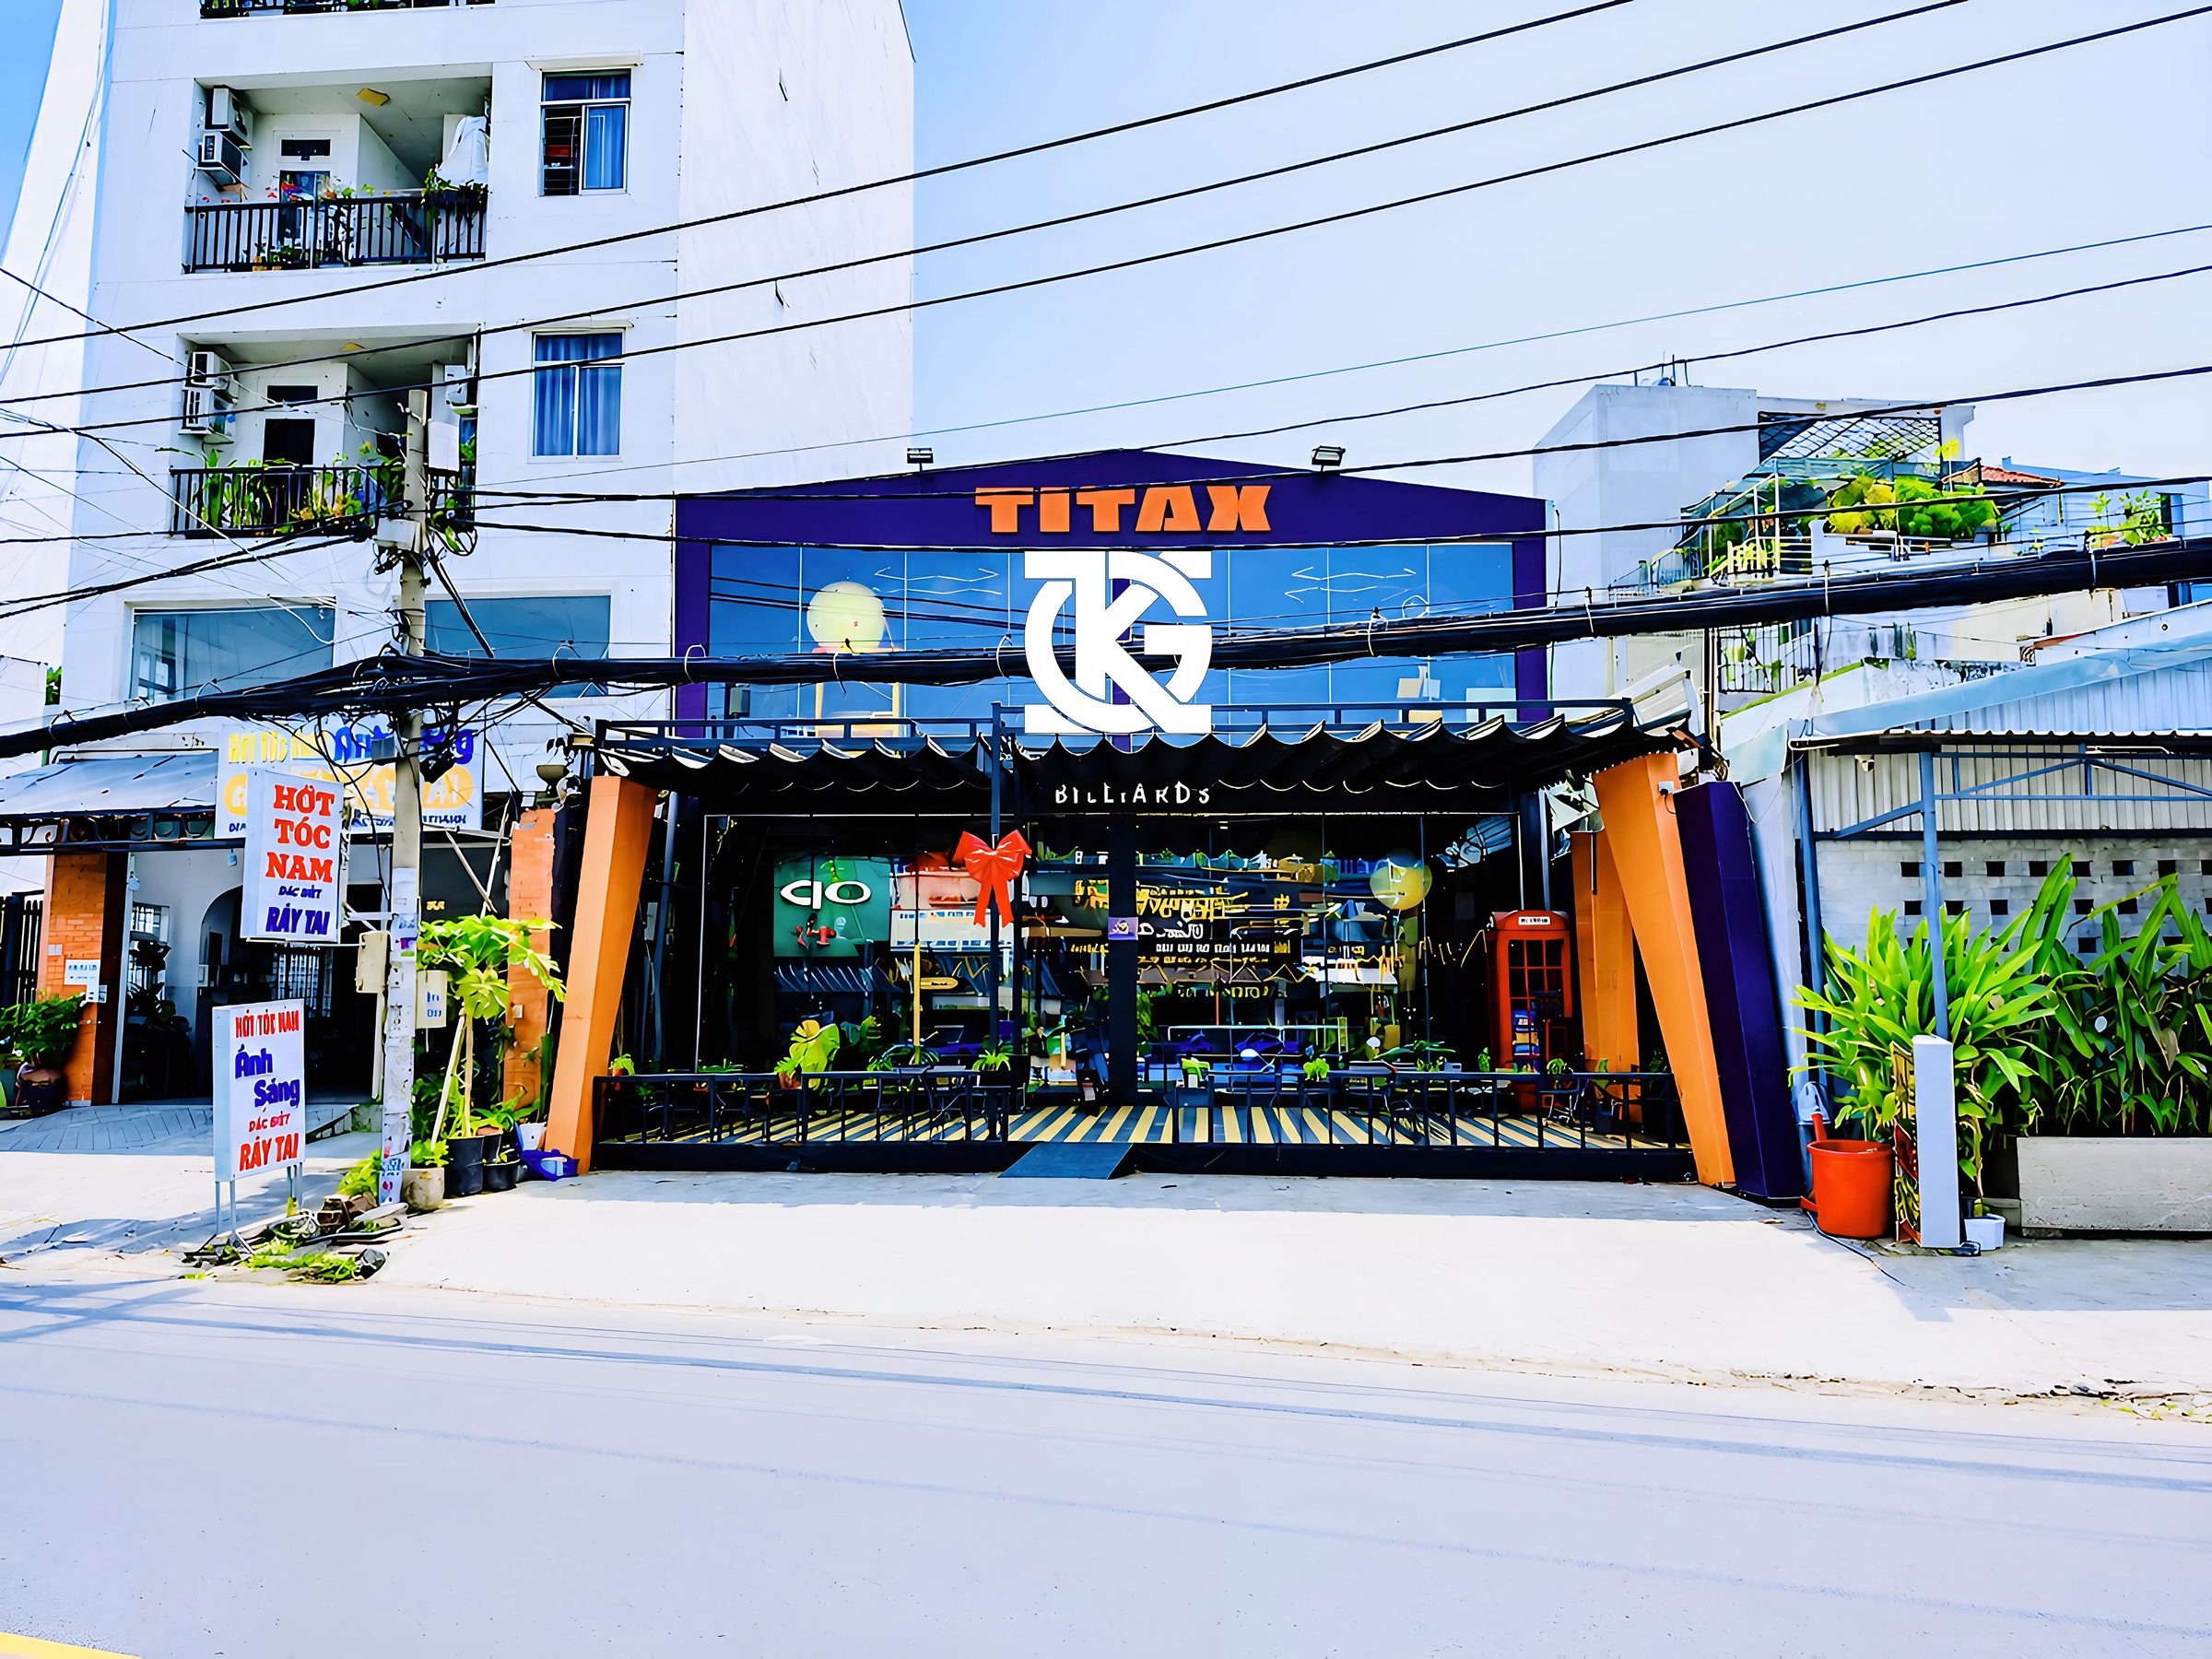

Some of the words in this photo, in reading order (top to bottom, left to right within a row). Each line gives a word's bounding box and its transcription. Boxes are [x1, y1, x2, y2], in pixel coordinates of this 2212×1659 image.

[974, 485, 1272, 533] TITAX
[1054, 782, 1210, 805] BILLIARDS
[274, 816, 332, 849] TÓC
[265, 852, 333, 883] NAM
[265, 902, 303, 934] RÁY
[305, 910, 331, 935] TAI
[235, 1043, 273, 1079] Ánh
[253, 1077, 300, 1108] Sáng
[240, 1135, 272, 1171] RÁY
[275, 1133, 300, 1162] TAI
